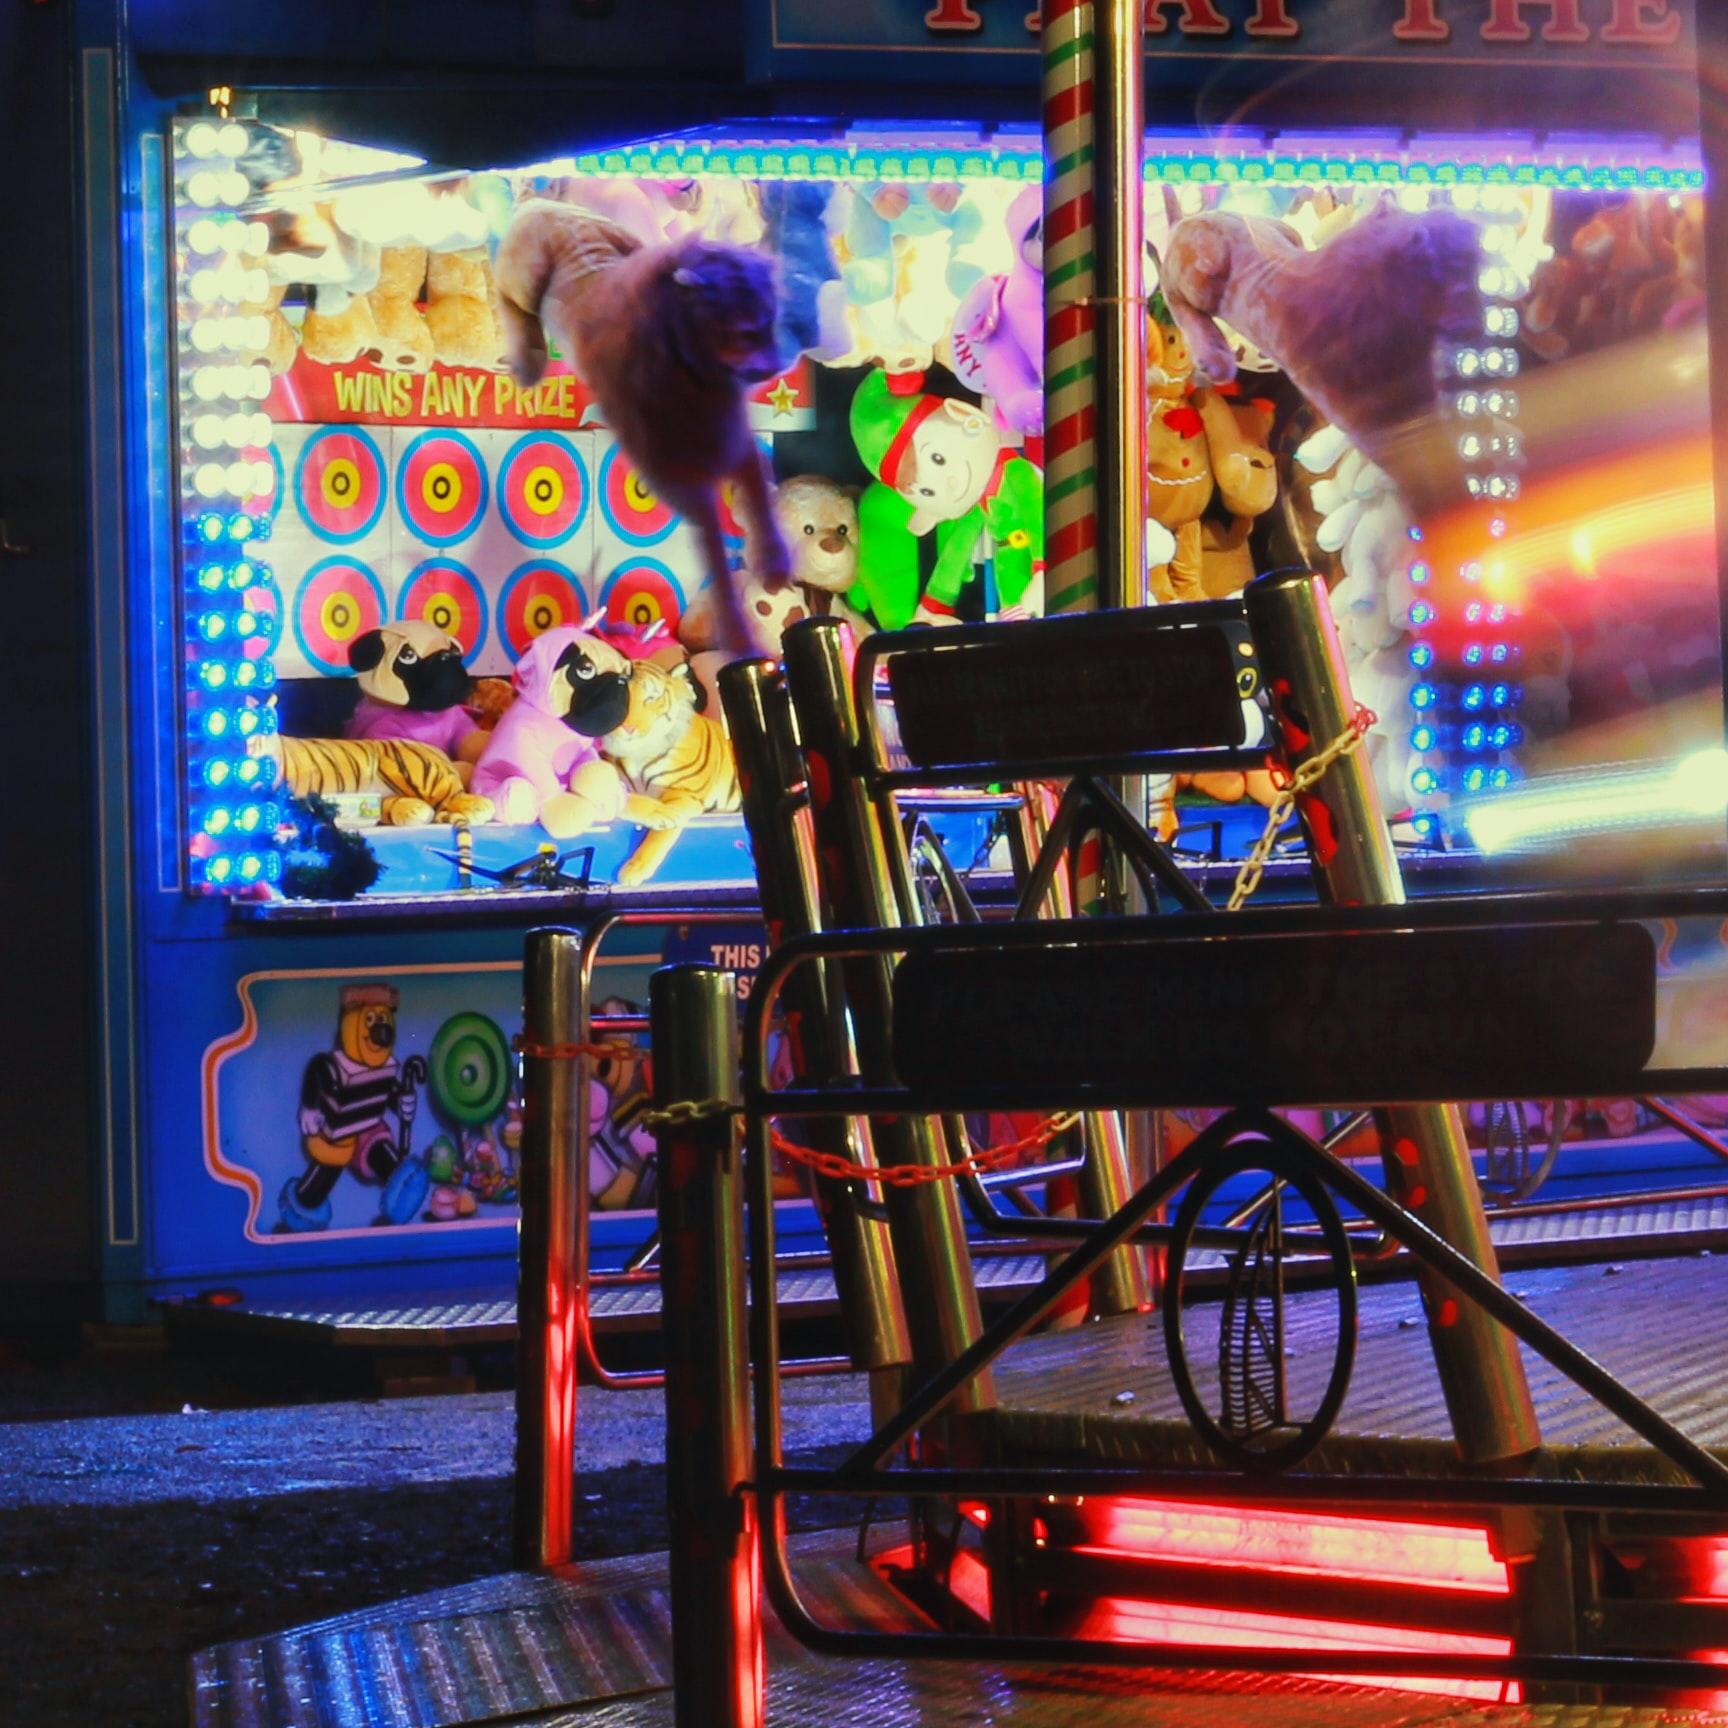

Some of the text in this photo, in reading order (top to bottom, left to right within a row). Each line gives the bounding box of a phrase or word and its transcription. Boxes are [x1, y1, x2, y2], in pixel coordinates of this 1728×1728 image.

[333, 371, 577, 419] WINS ANY PRIZE
[711, 944, 761, 969] THIS
